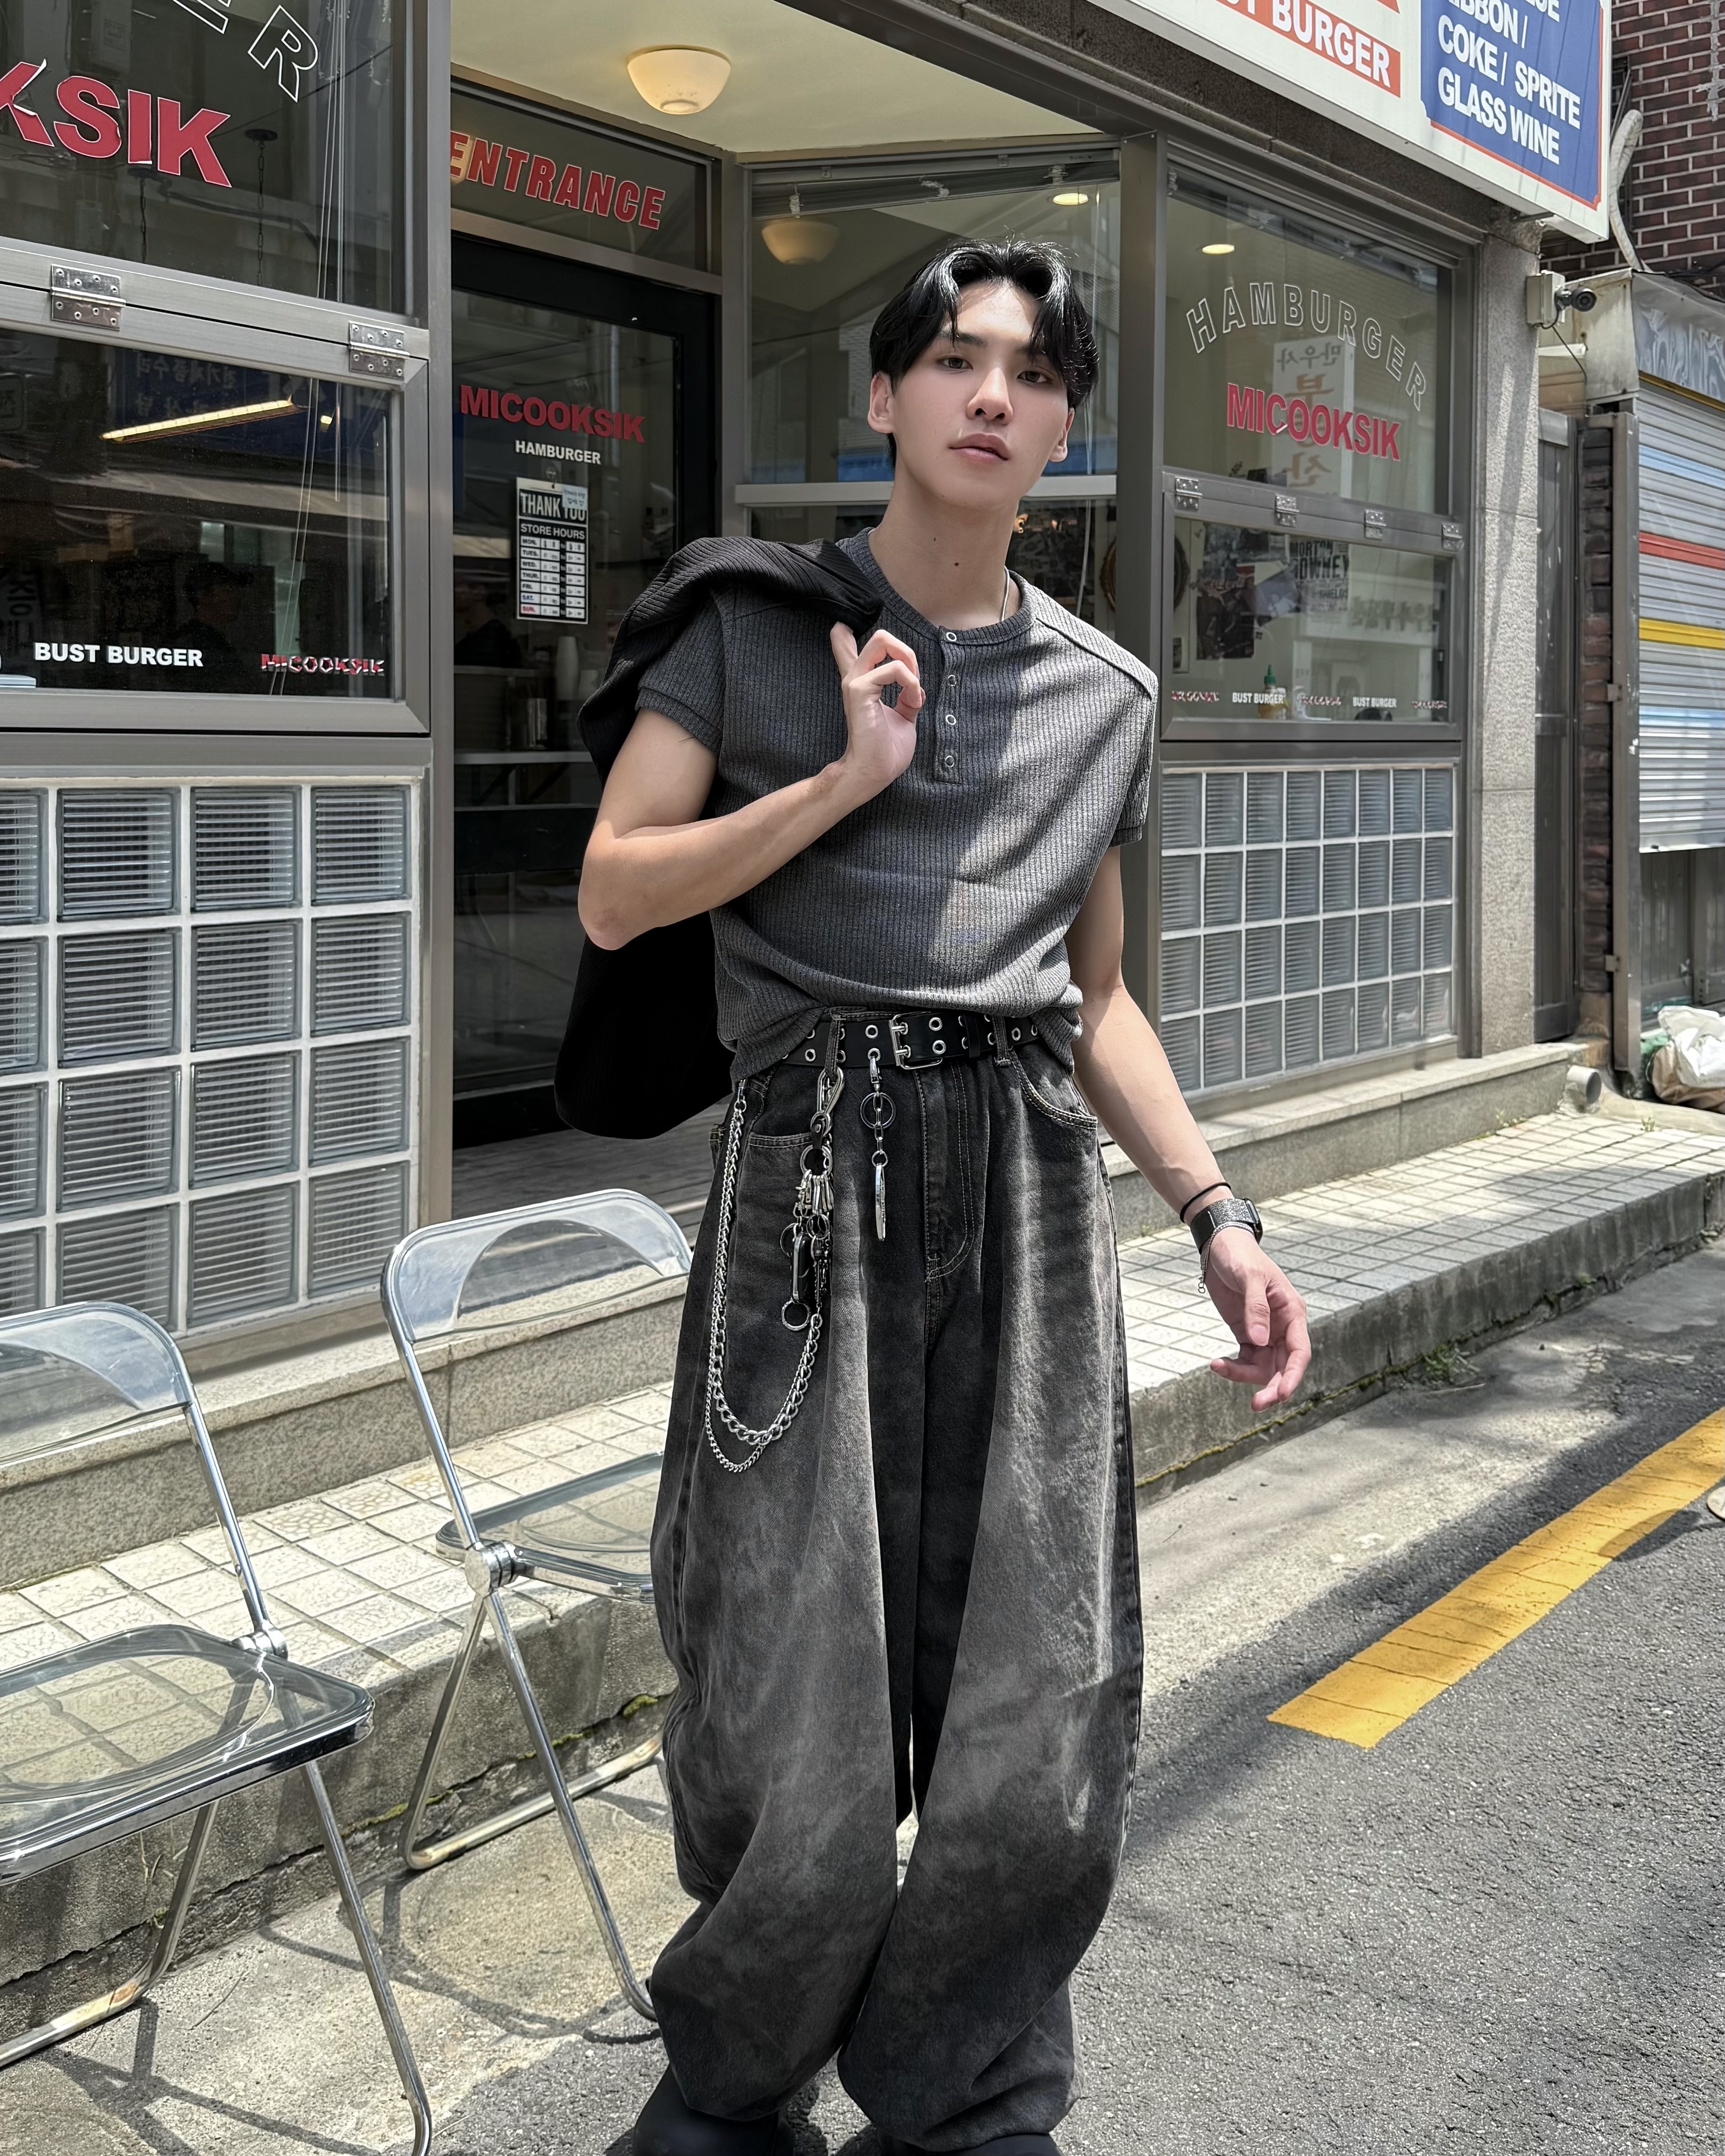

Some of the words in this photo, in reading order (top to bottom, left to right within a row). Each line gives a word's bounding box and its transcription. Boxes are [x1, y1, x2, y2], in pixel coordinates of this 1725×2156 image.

[1272, 0, 1391, 88] BURGER
[1438, 15, 1498, 82] COKE
[1515, 60, 1581, 130] SPRITE
[1438, 67, 1507, 135] GLASS
[1510, 105, 1560, 165] WINE
[450, 130, 666, 230] ENTRANCE
[1185, 282, 1427, 412] HAMBURGER
[461, 384, 645, 443] MICOOKSIK
[1227, 383, 1401, 462] MICOOKSIK
[515, 439, 602, 465] HAMBURGER
[520, 492, 561, 518] THANK
[521, 523, 552, 536] STORE
[553, 527, 585, 540] HOURS
[34, 642, 100, 663] BUST
[107, 645, 203, 667] BURGER
[1232, 692, 1253, 703] BUST
[1254, 693, 1284, 704] BURGER
[1352, 696, 1370, 707] BUST
[1371, 697, 1397, 708] BURGER
